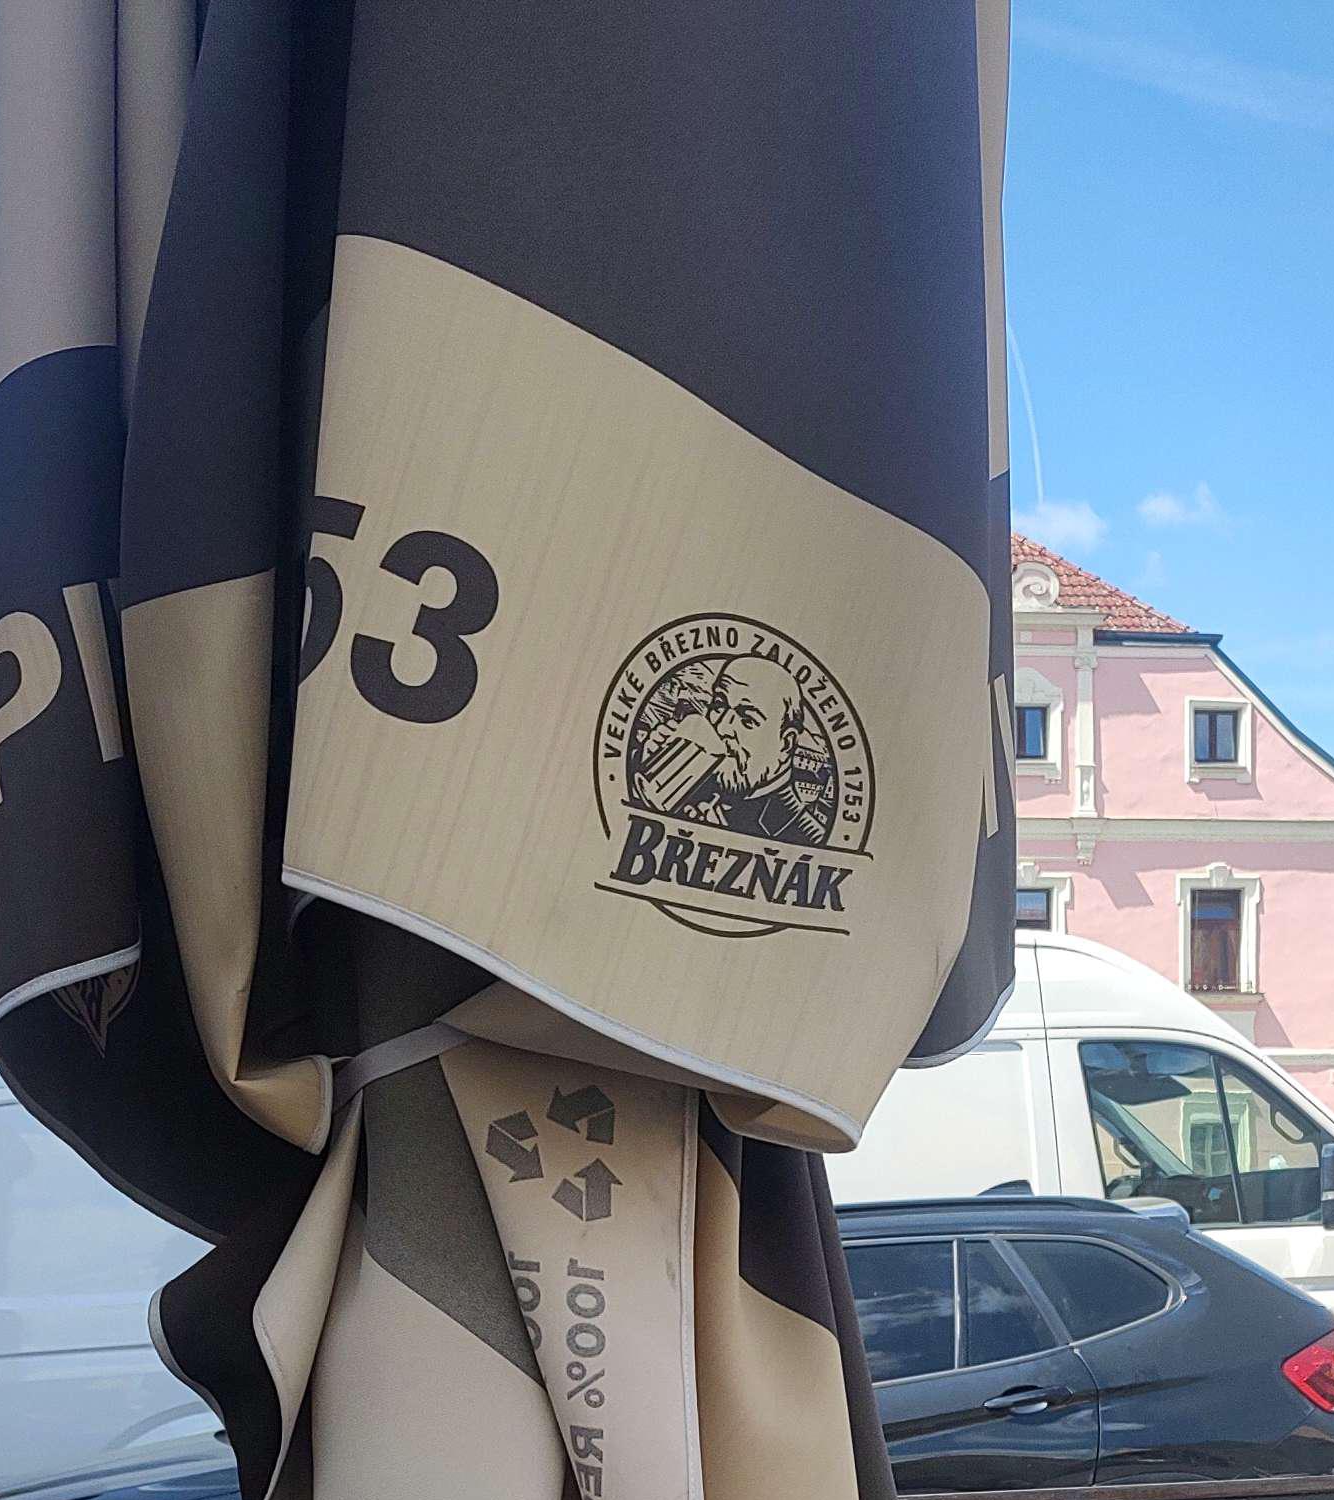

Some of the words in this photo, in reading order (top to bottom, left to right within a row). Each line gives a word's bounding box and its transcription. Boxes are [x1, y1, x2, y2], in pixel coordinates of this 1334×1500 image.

[604, 669, 645, 759] VELKÉ
[643, 625, 739, 675] BŘEZNO
[750, 633, 857, 752] ZALOŽENO
[841, 765, 864, 824] 1753
[609, 812, 854, 913] BŘEZŇÁK
